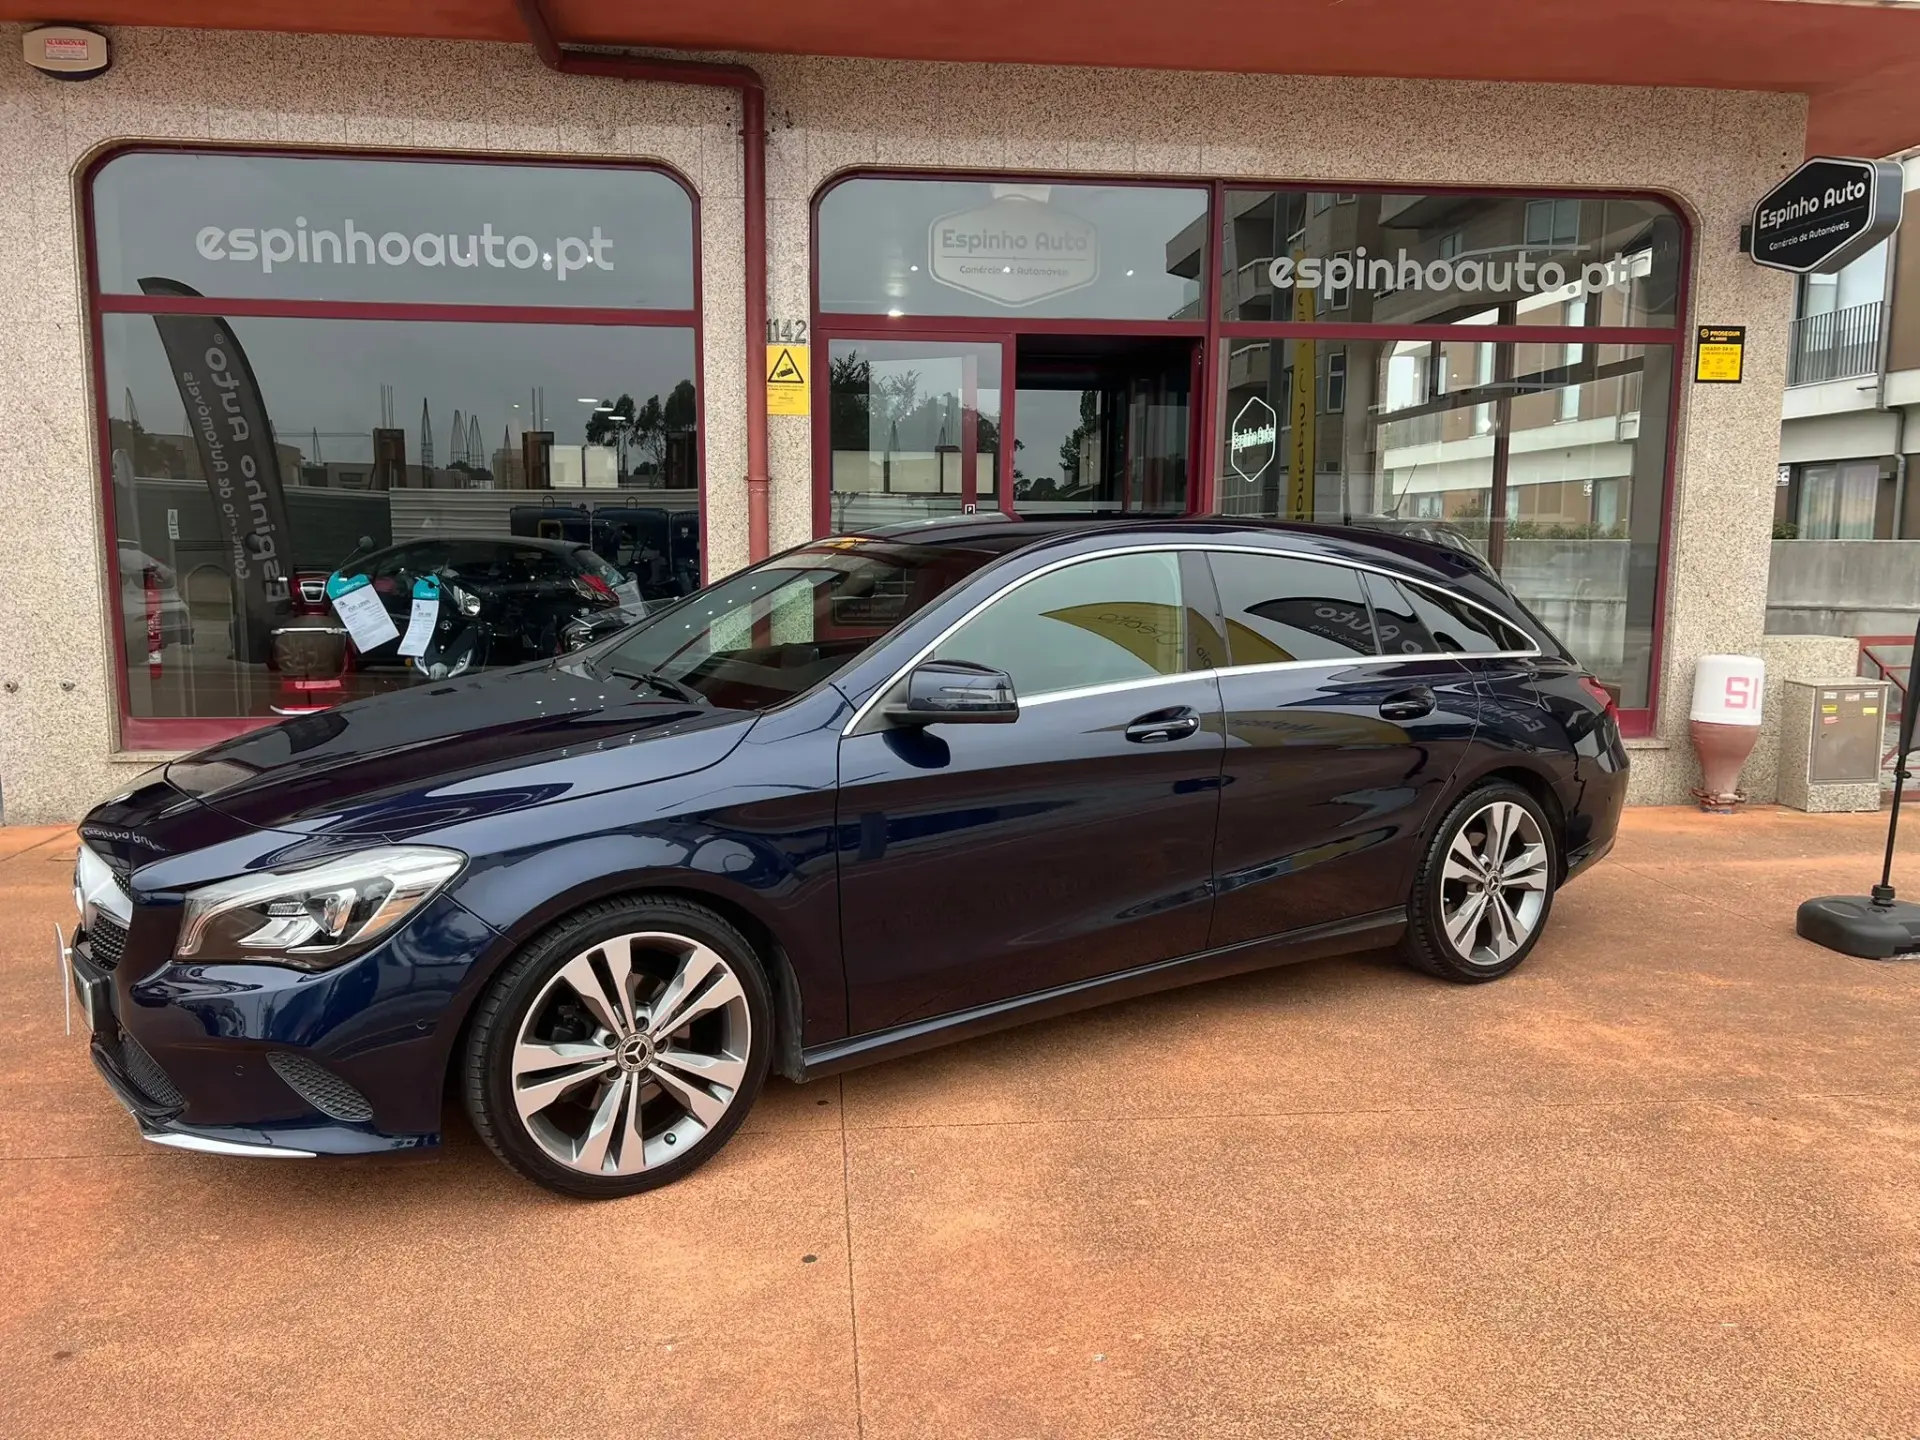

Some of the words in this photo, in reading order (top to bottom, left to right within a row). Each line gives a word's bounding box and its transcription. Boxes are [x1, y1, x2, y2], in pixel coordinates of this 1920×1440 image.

[1760, 196, 1820, 230] Espinho
[1823, 180, 1866, 209] Auto
[942, 229, 1028, 253] Espinho
[1035, 231, 1088, 252] Auto
[1799, 232, 1808, 242] de
[1808, 220, 1850, 240] Automóveis
[195, 216, 614, 281] espinhoauto.pt
[1003, 265, 1015, 276] e
[1268, 246, 1631, 300] espinhoauto.pt
[766, 318, 807, 343] 1142
[1232, 427, 1257, 453] Espinho
